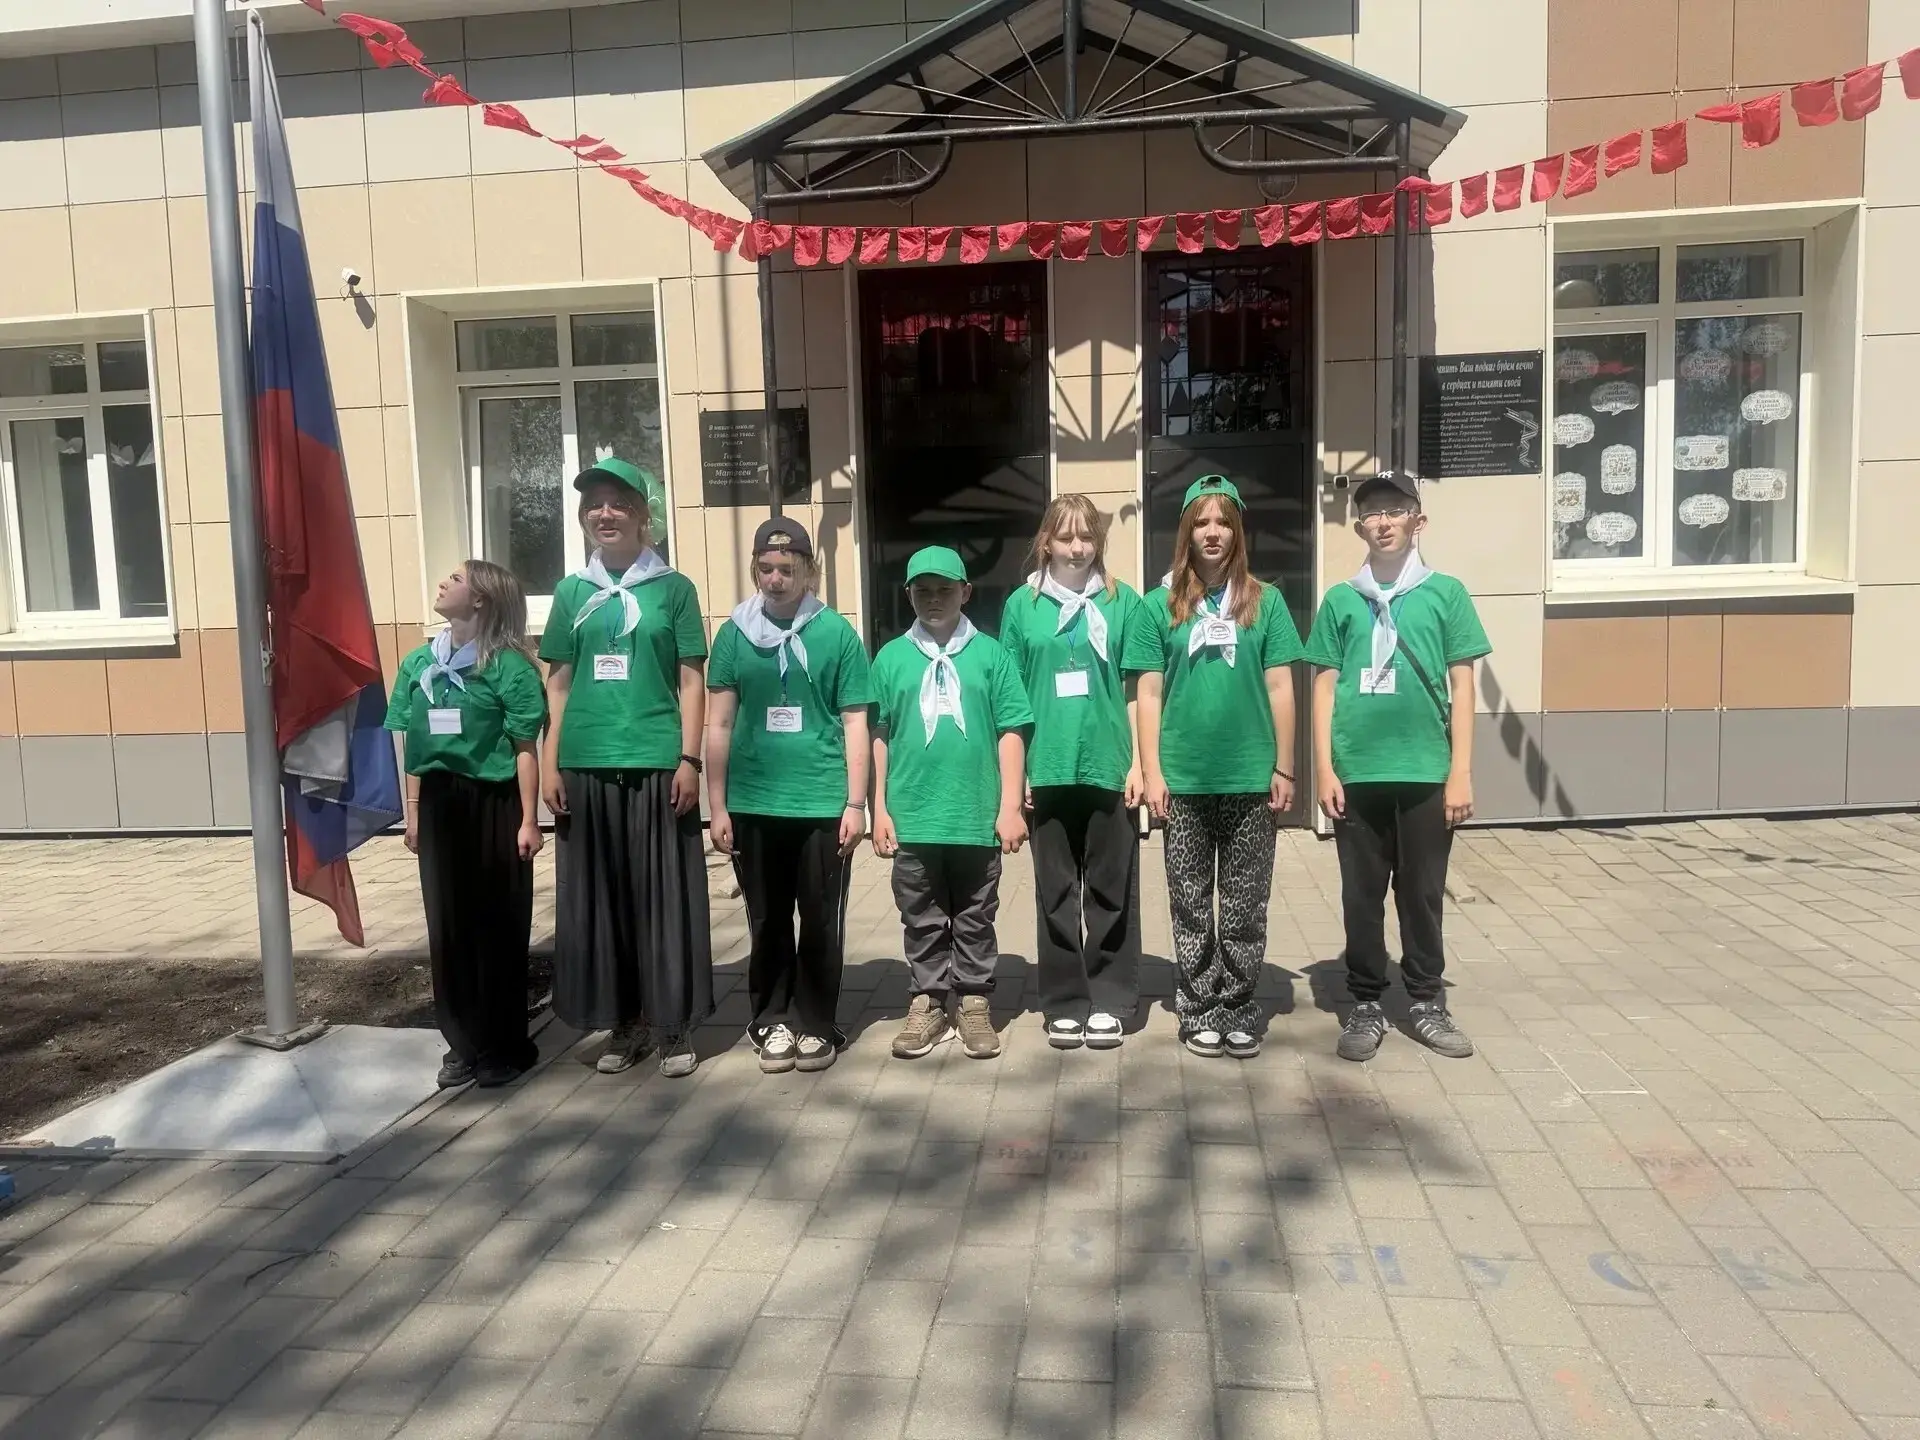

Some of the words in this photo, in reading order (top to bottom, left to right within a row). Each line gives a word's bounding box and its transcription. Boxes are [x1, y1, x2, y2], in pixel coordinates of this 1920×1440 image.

[1459, 360, 1474, 373] Ваш
[1496, 359, 1515, 375] будем
[1515, 361, 1534, 371] вечно
[1446, 378, 1471, 393] сердцах
[1471, 381, 1477, 389] и
[1477, 379, 1504, 389] памяти
[1504, 376, 1522, 388] своей
[721, 440, 744, 448] учся
[703, 461, 739, 469] Советскоо
